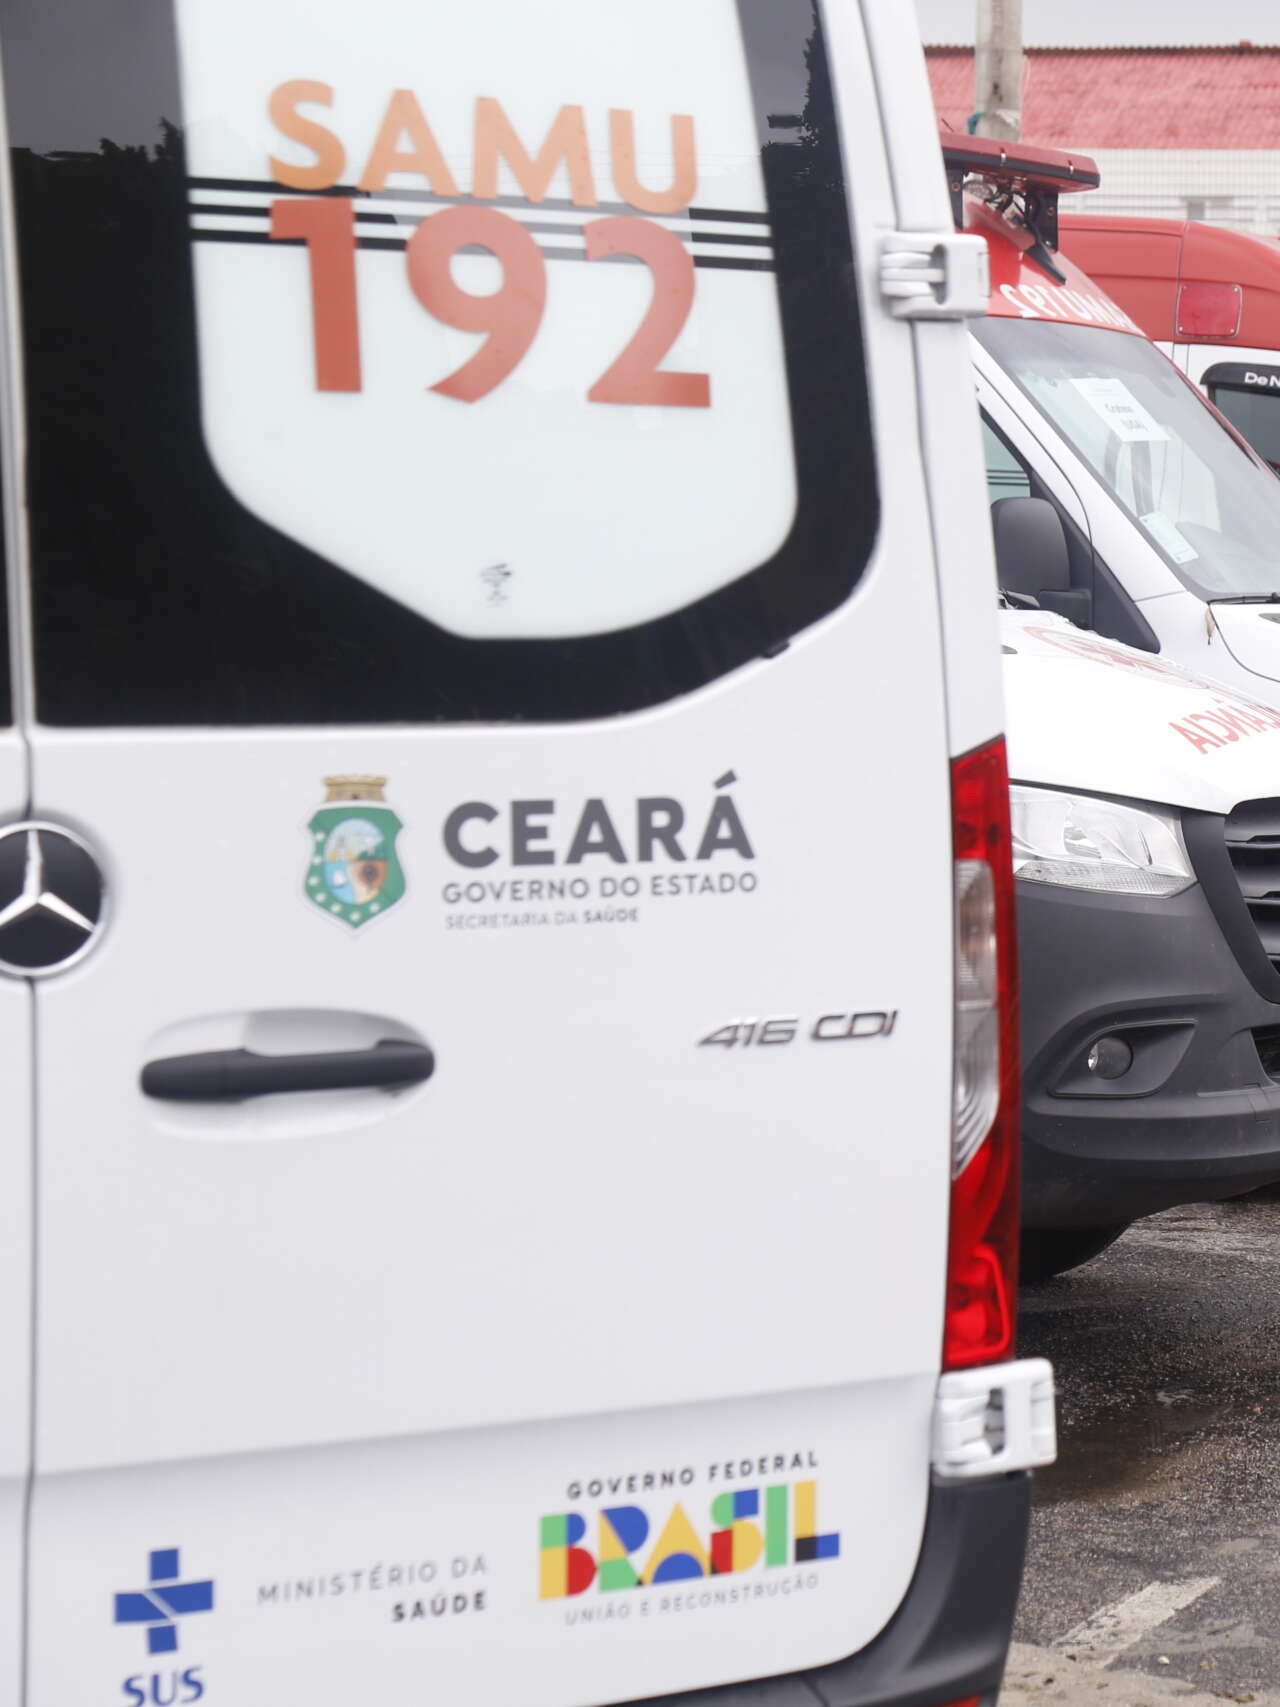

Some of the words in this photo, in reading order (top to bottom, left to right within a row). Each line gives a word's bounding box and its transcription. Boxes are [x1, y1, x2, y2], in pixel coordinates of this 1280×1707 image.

[266, 79, 698, 214] SAMU
[269, 196, 712, 408] 192
[1244, 371, 1268, 386] De
[442, 769, 755, 869] CEARÁ
[442, 877, 590, 904] GOVERNO
[599, 876, 640, 898] DO
[651, 872, 758, 897] ESTADO
[444, 912, 549, 931] SECRETARIA
[554, 911, 577, 926] DA
[583, 905, 638, 925] SAÚDE
[697, 1018, 799, 1049] 416
[810, 1009, 898, 1041] CDI
[566, 1467, 696, 1501] GOVERNO
[708, 1450, 819, 1482] FEDERAL
[539, 1479, 841, 1600] BRASIL
[256, 1559, 438, 1605] MINISTÉRIO
[451, 1553, 489, 1580] DA
[564, 1598, 631, 1627] UNIÃO
[639, 1598, 650, 1617] E
[659, 1571, 820, 1612] RECONSTRUÇÃO
[391, 1588, 488, 1624] SAÚDE
[121, 1665, 206, 1707] SUS
